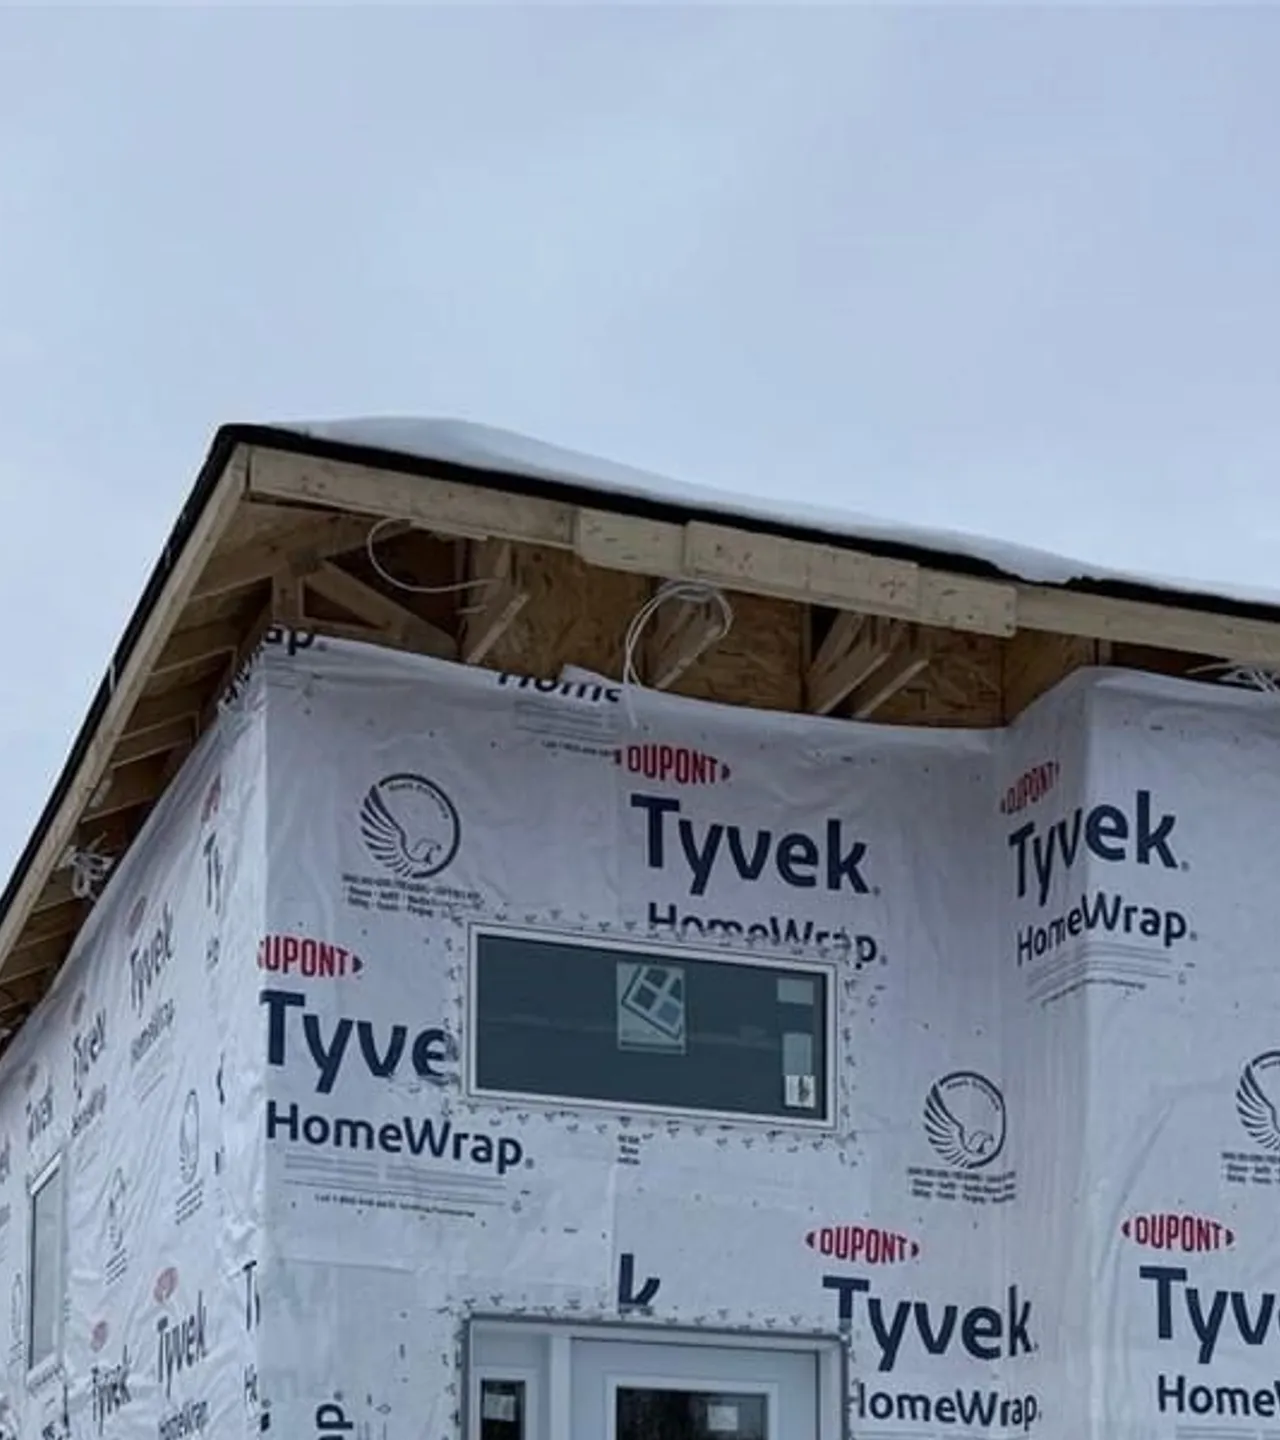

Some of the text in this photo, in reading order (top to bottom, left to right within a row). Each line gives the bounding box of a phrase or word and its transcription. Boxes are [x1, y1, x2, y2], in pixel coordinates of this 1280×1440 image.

[628, 745, 719, 784] DUPONT
[631, 793, 869, 896] Tyvek
[1008, 790, 1178, 906] Tyvek
[257, 934, 349, 978] UPONT
[1019, 892, 1187, 966] HomeWrap
[267, 1100, 523, 1174] HomeWrap
[821, 1226, 908, 1264] DUPONT
[1135, 1214, 1222, 1252] DUPONT
[823, 1275, 1033, 1373] Tyvek
